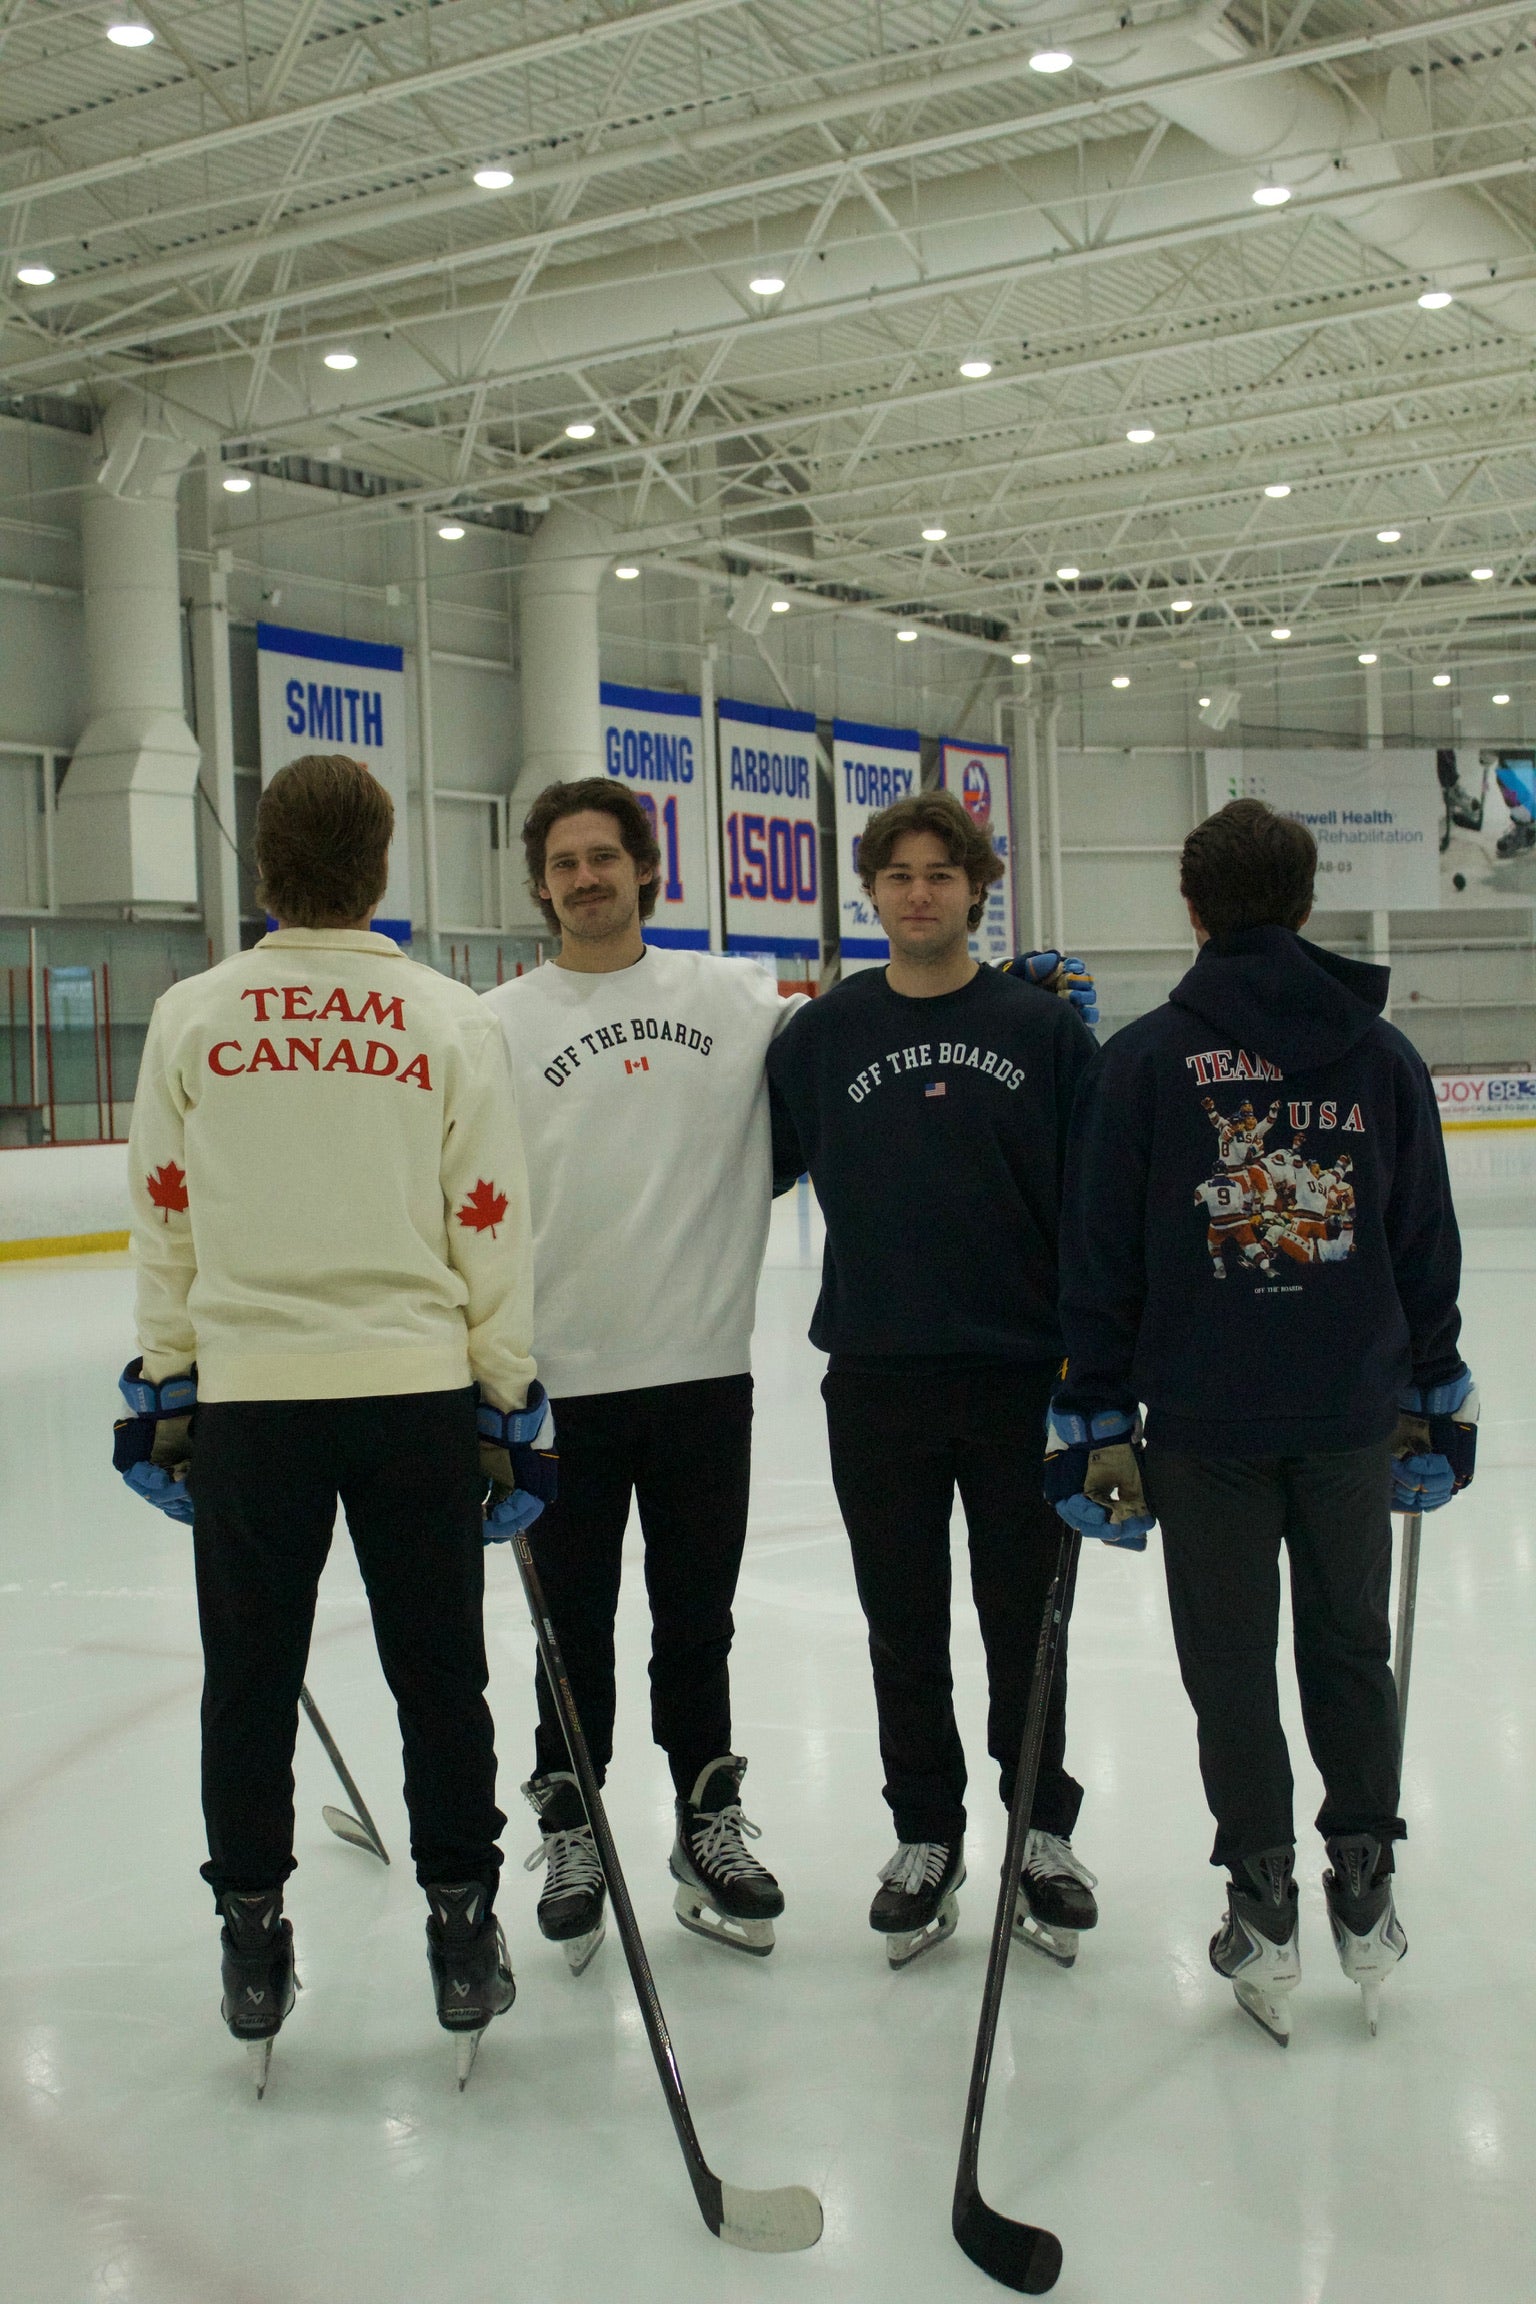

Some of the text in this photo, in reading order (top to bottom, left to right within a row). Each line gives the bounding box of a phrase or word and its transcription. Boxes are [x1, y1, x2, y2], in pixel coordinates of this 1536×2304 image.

[286, 679, 383, 747] SMITH
[606, 726, 694, 784] GORING
[731, 746, 810, 799] ARBOUR
[1318, 829, 1423, 844] Rehabilitation
[1342, 810, 1393, 824] Health
[727, 811, 818, 904] 1500
[241, 985, 406, 1031] TEAM
[208, 1038, 433, 1091] CANADA
[544, 1018, 713, 1087] OFF THE BOARDS
[848, 1042, 1025, 1103] OFF THE BOARDS
[1186, 1049, 1283, 1086] TEAM
[1288, 1101, 1365, 1132] USA
[1217, 1187, 1231, 1206] 9
